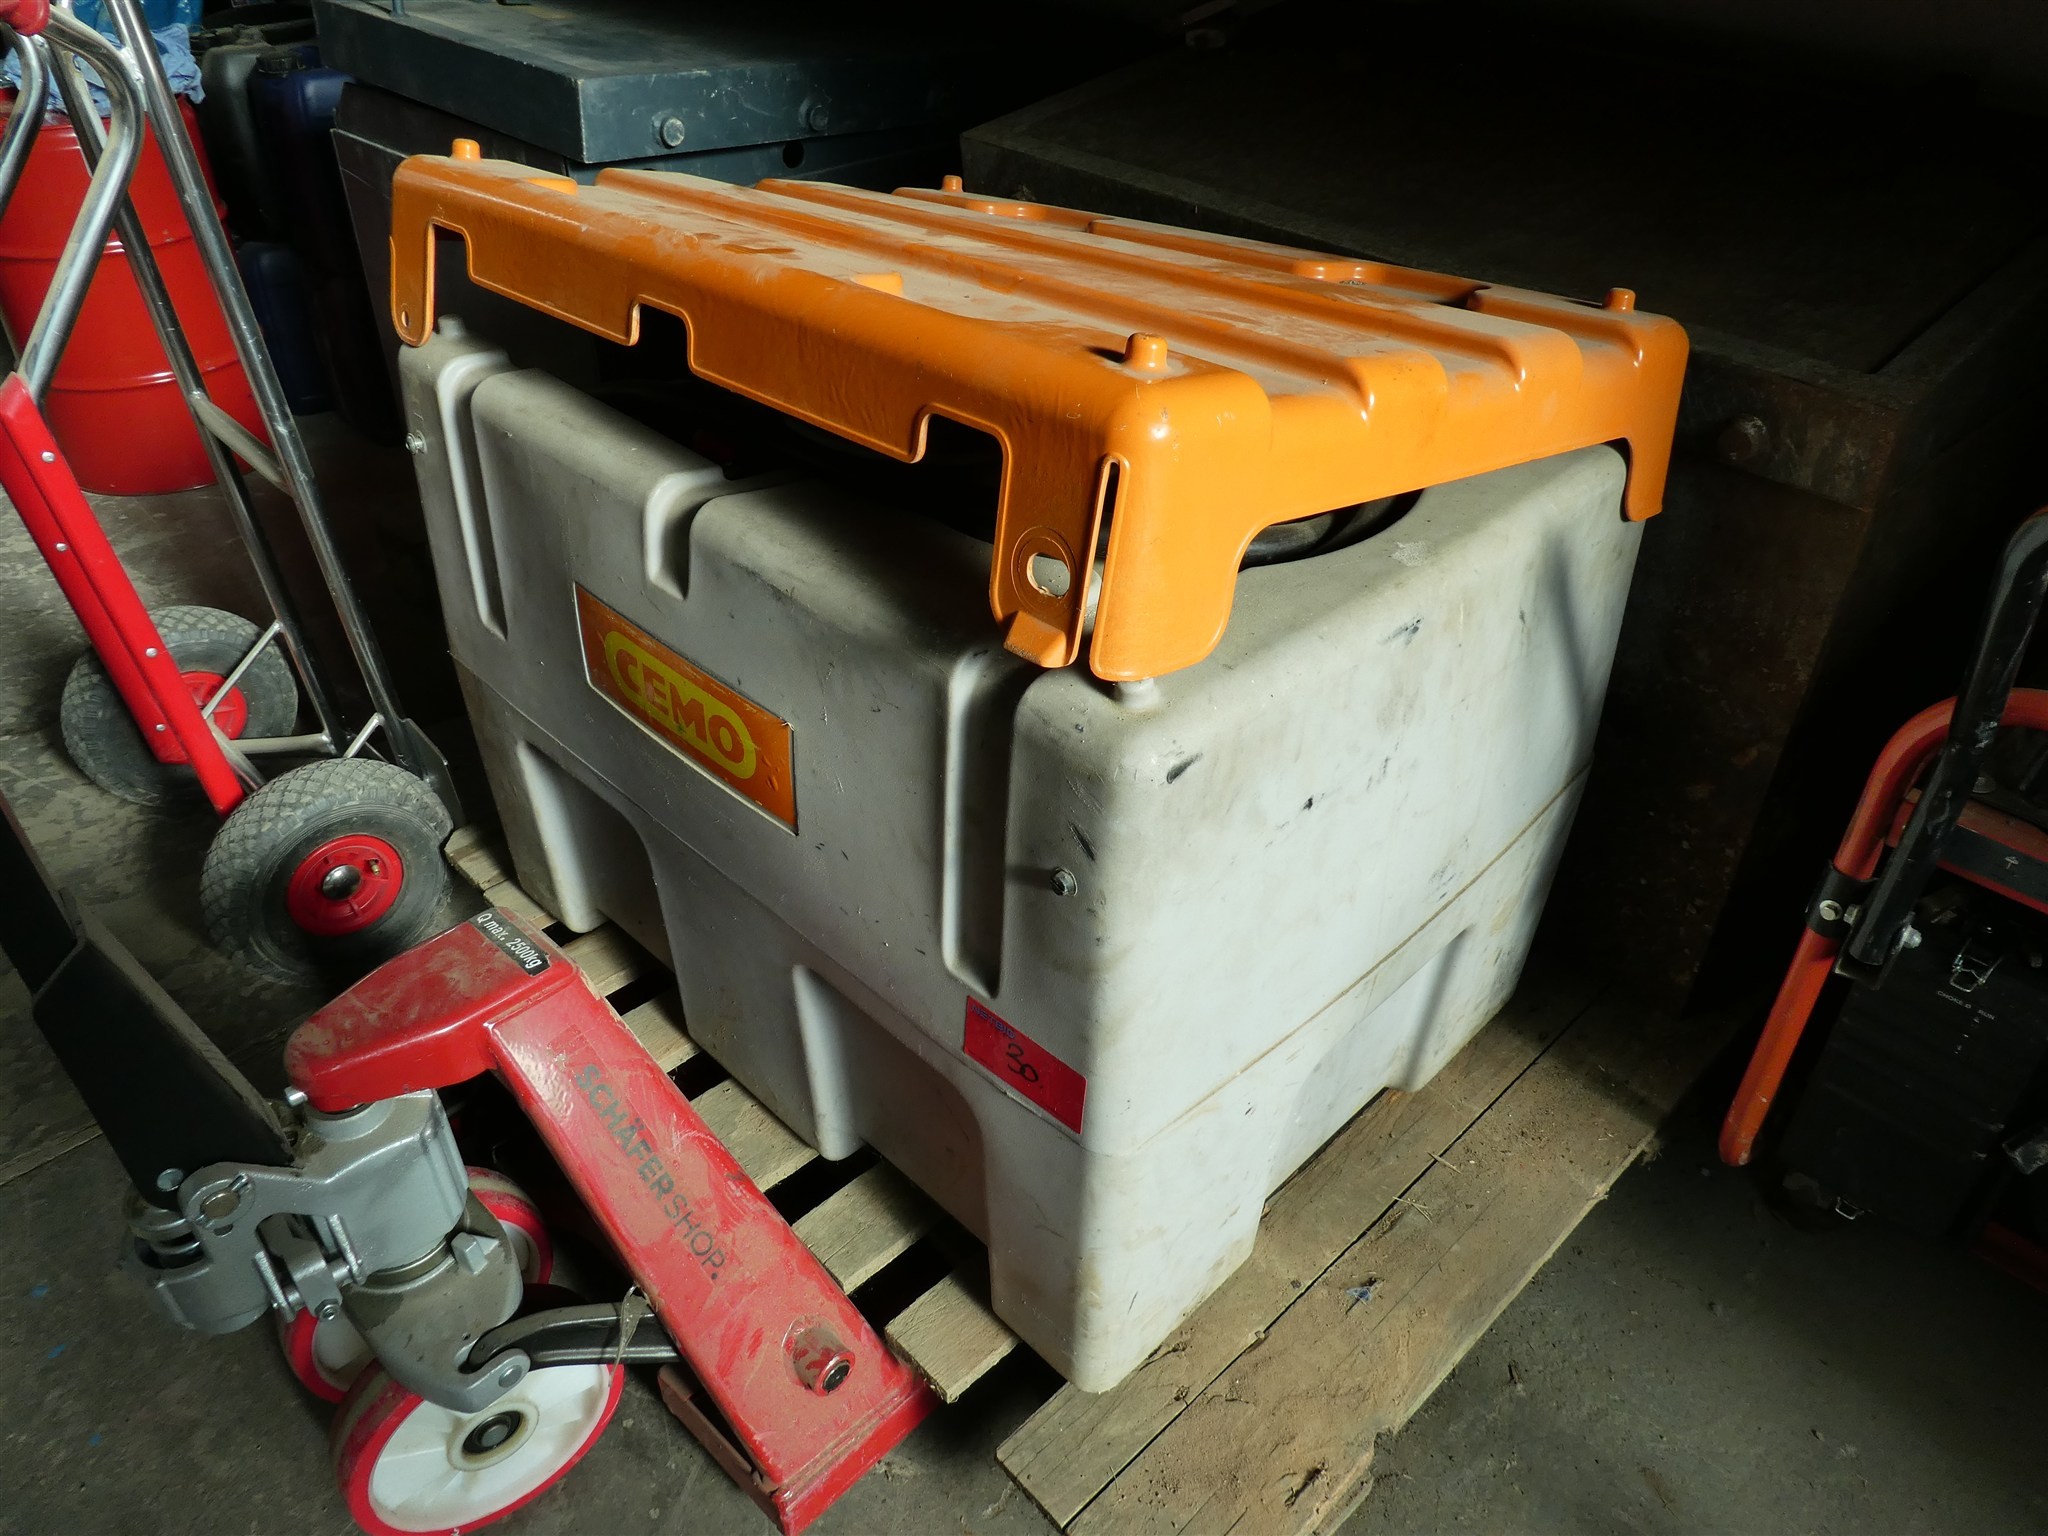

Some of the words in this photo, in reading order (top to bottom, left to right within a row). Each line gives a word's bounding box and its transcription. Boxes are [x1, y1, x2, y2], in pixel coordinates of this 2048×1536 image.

[616, 649, 745, 764] CEMO
[477, 913, 492, 924] Q
[484, 921, 508, 941] max.
[505, 938, 542, 968] 2500kg
[576, 1064, 675, 1200] SCHÄFER
